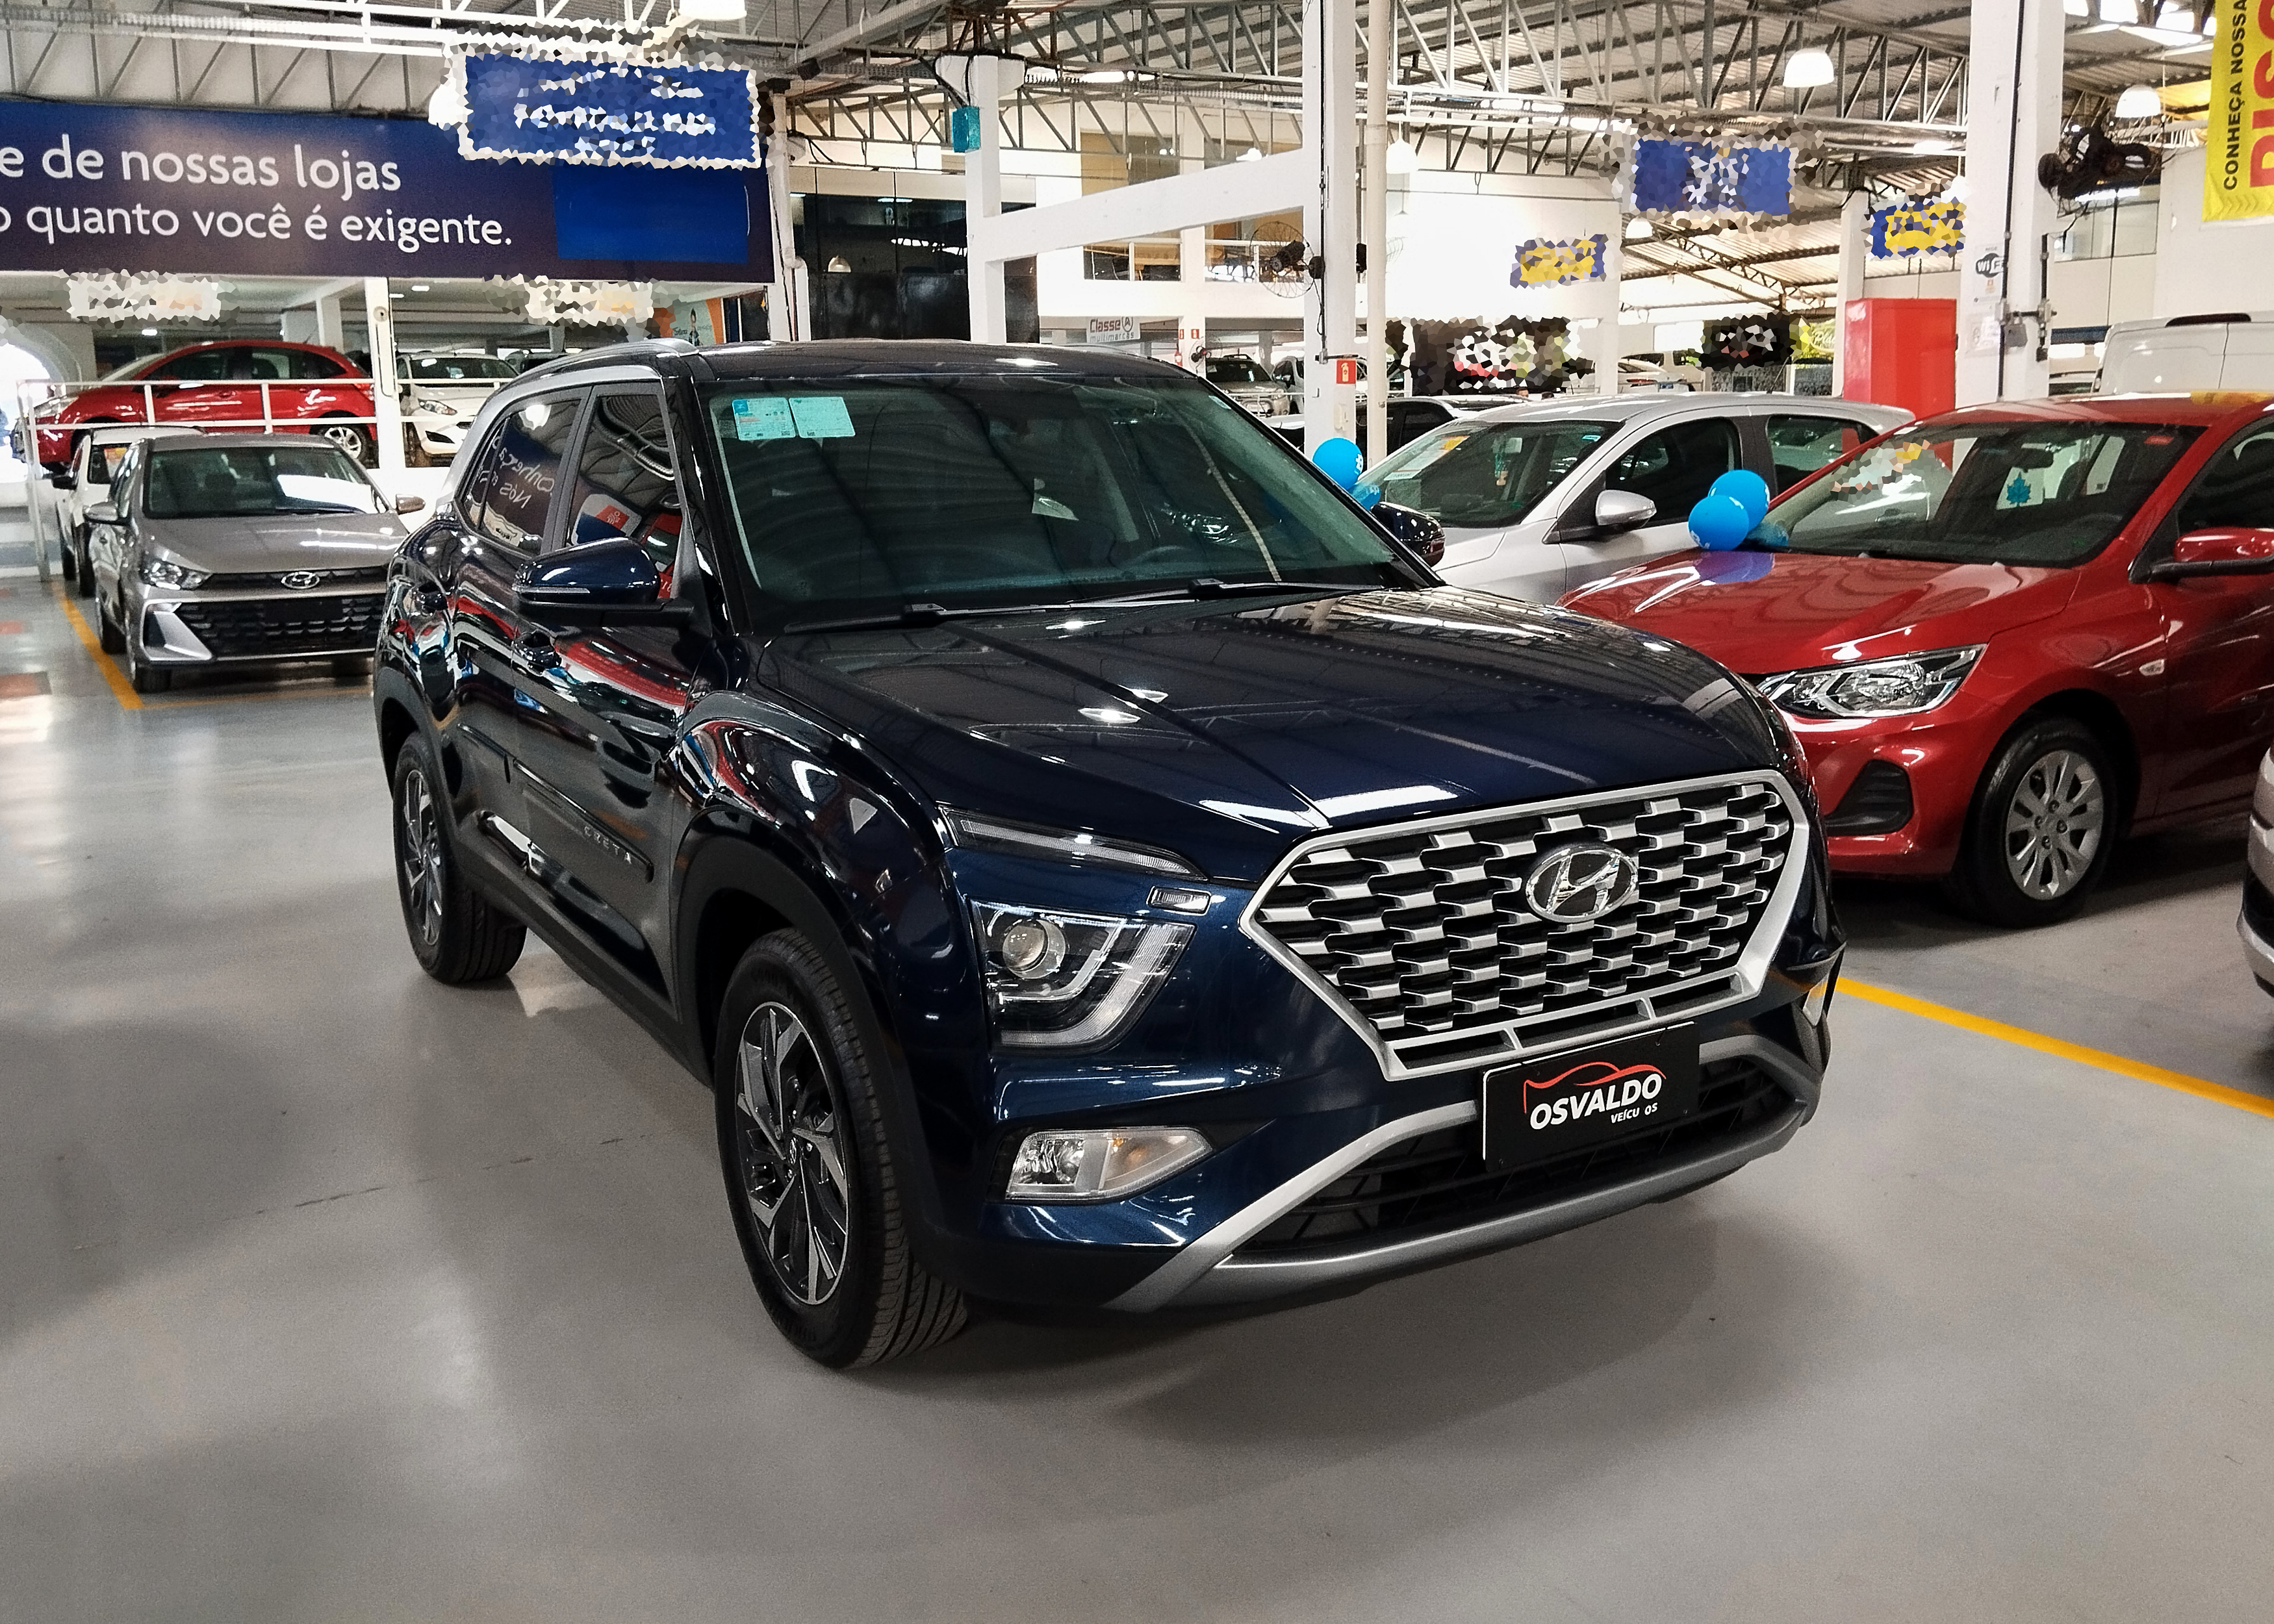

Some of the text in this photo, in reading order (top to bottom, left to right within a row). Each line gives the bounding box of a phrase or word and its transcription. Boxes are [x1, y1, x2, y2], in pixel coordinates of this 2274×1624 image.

[2223, 81, 2245, 190] CONHEÇA
[0, 134, 401, 201] e de nossas lojas
[27, 203, 179, 244] quanto
[192, 202, 292, 239] você
[305, 203, 327, 240] é
[340, 209, 512, 253] exigente.
[1090, 318, 1121, 333] Classe
[1090, 332, 1134, 344] multimarcas
[1530, 1073, 1662, 1130] OSVALDO
